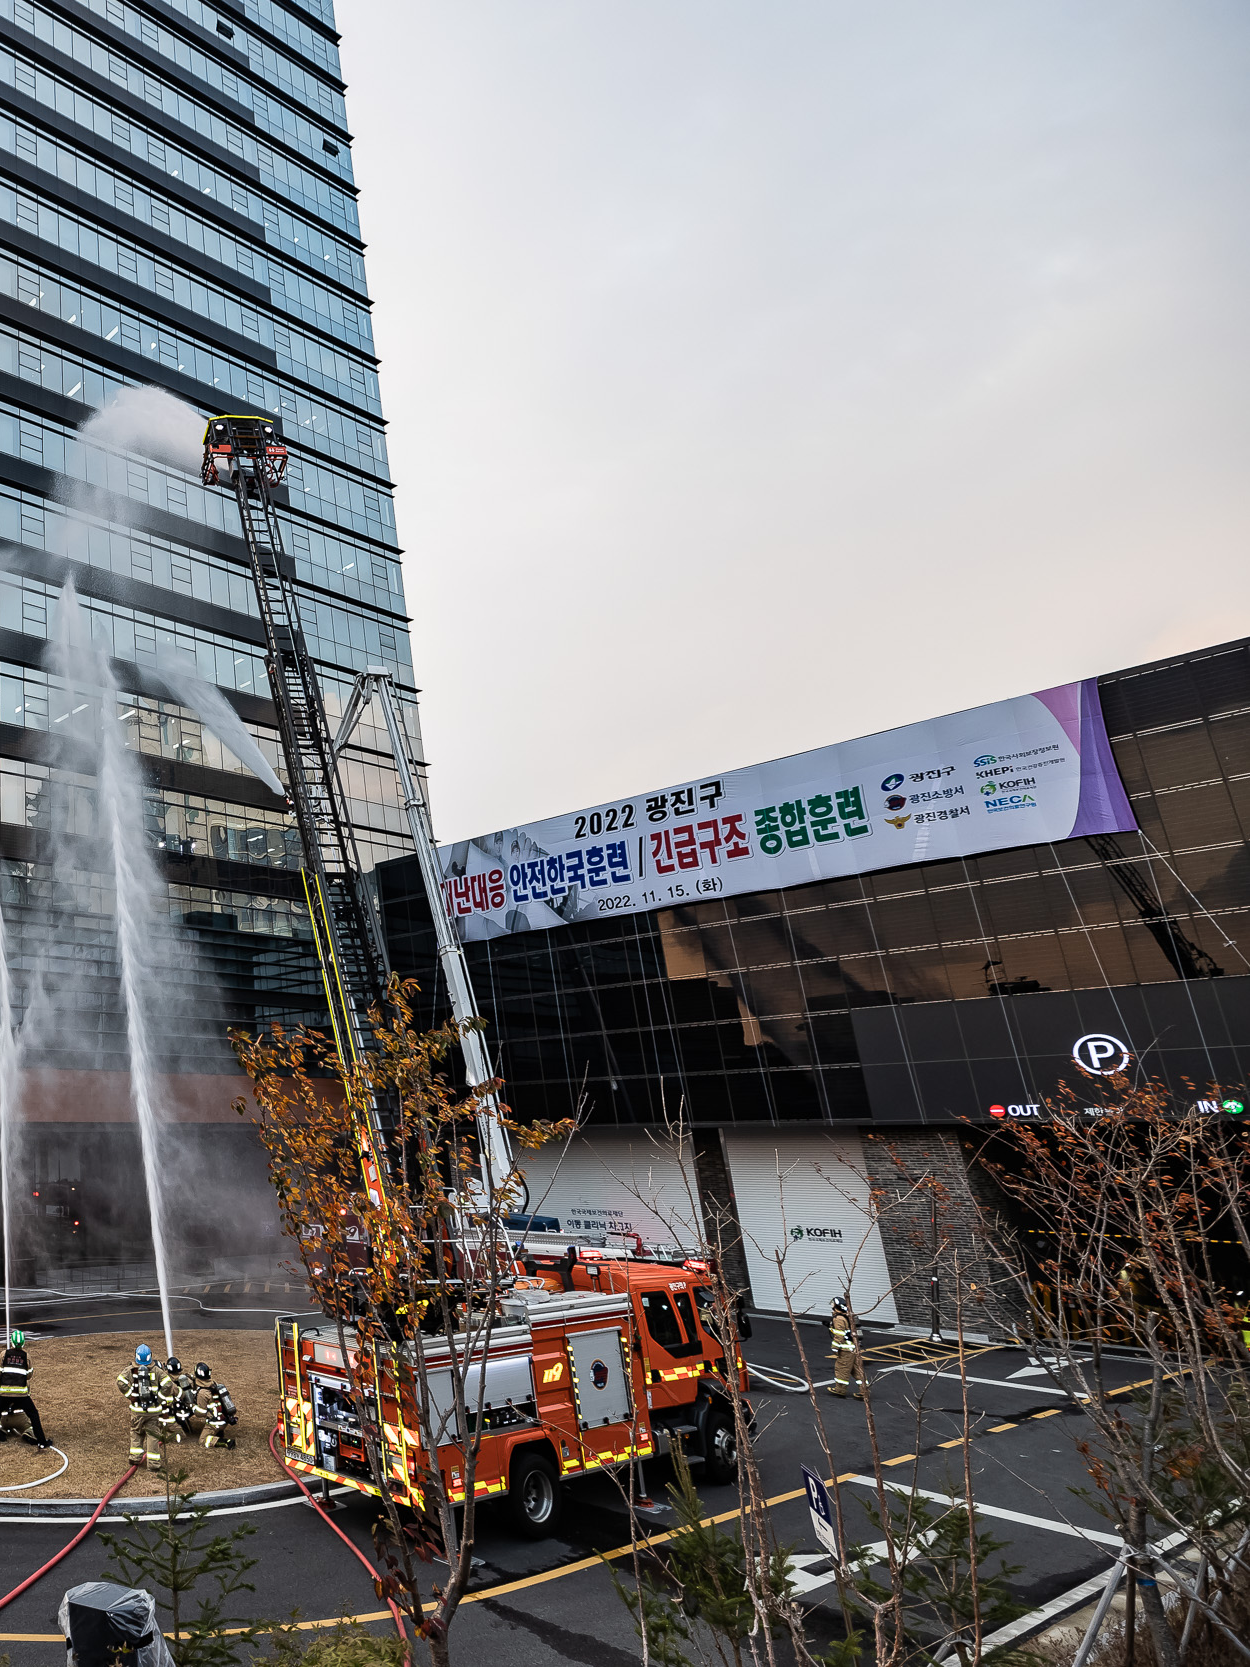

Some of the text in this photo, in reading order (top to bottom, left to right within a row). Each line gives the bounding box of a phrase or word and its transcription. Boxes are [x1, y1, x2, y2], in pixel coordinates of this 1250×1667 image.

[909, 766, 956, 782] 광진구
[999, 777, 1036, 790] KOFIH
[909, 785, 964, 804] 광진소방서
[984, 795, 1035, 808] NECA
[574, 780, 723, 839] 2022 광진구
[914, 806, 970, 824] 광진경찰서
[510, 840, 632, 903] 안전한국훈련
[650, 813, 750, 875] 긴급구조
[754, 785, 869, 855] 종합훈련
[597, 876, 723, 911] 2022. 11. 15. (화)
[1087, 1041, 1115, 1068] P
[1007, 1104, 1040, 1117] OUT
[1197, 1100, 1219, 1114] IN
[566, 1220, 581, 1229] 이동
[584, 1221, 607, 1230] 클리닉
[806, 1228, 842, 1238] KOFIH
[543, 1362, 564, 1384] 119
